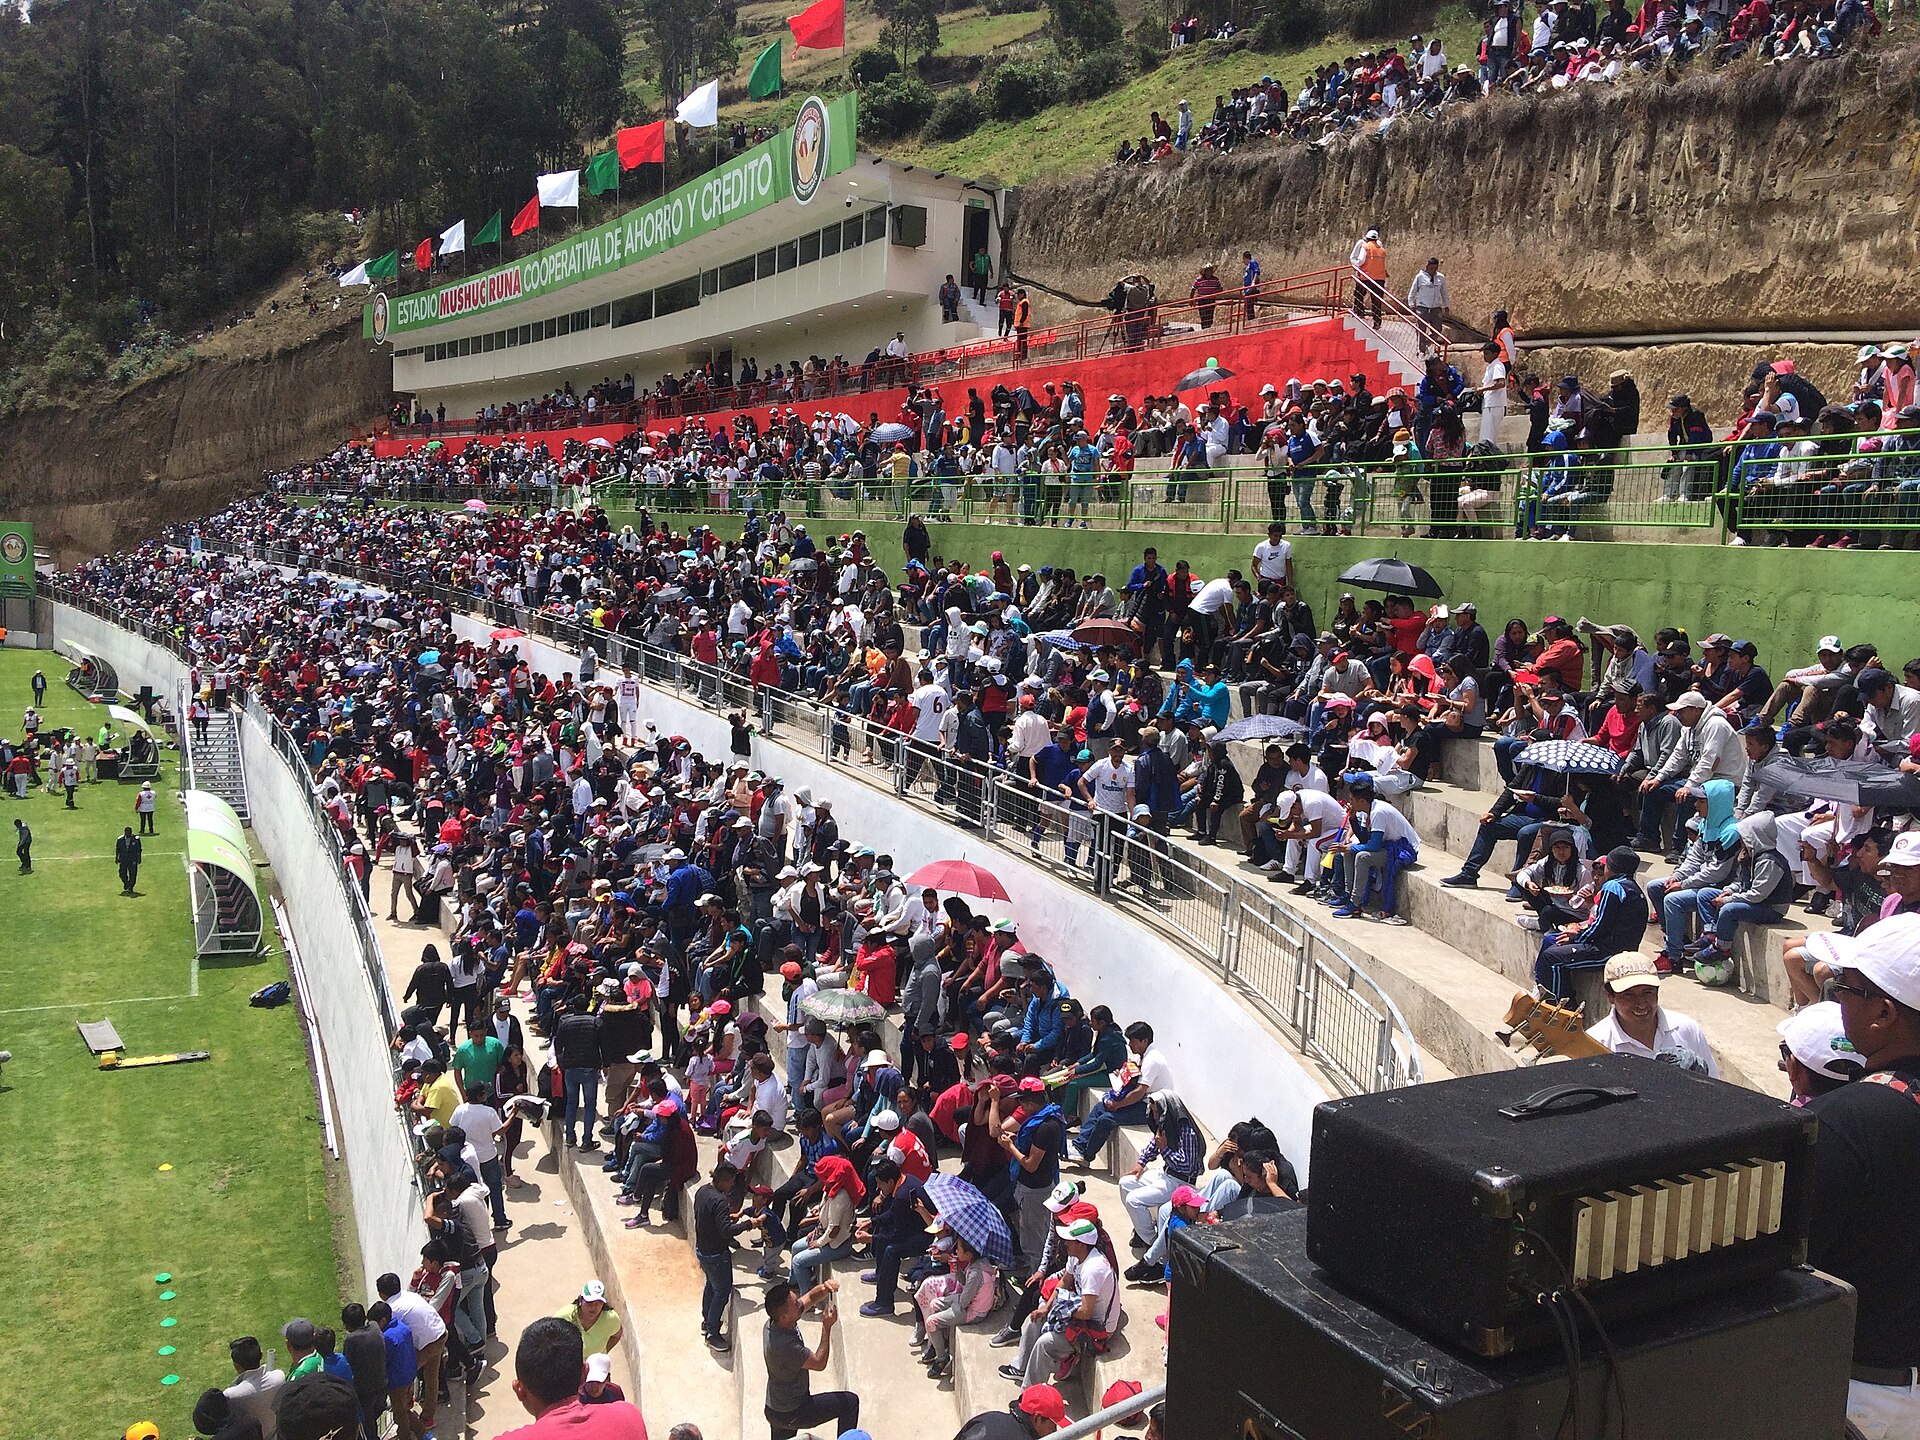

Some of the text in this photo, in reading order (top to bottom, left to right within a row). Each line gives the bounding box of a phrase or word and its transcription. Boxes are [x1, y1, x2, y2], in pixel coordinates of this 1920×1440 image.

[398, 293, 438, 325] ESTADIO
[439, 278, 487, 318] MUSHUC
[488, 266, 522, 305] RUNA
[523, 237, 601, 292] COOPERATIVA
[604, 227, 622, 264] DE
[624, 198, 683, 257] AHORRO
[686, 189, 698, 229] Y
[701, 153, 773, 222] CREDITO
[932, 696, 943, 714] 6
[1212, 774, 1226, 802] adida
